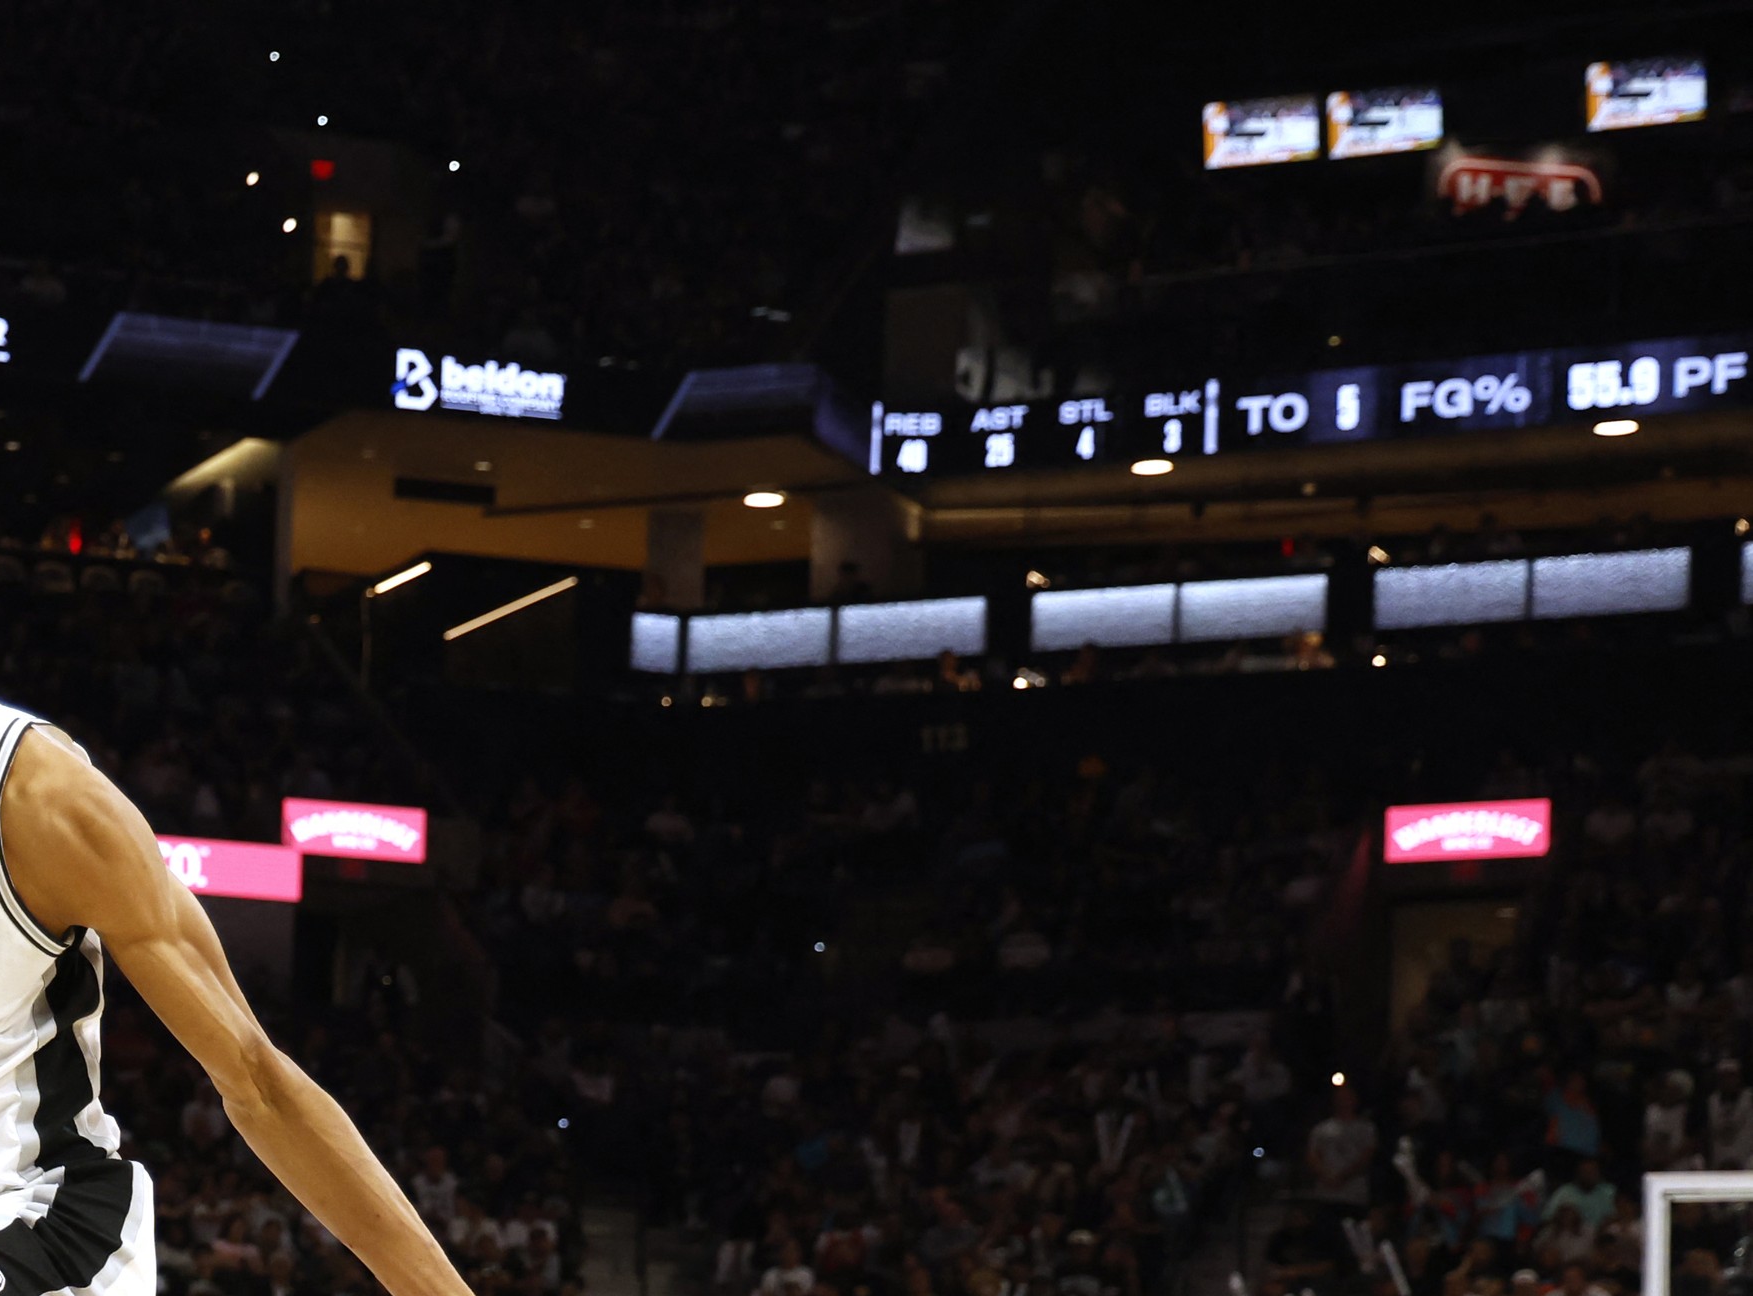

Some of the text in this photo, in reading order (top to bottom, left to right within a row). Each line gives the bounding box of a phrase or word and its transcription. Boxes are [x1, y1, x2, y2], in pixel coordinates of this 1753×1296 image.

[883, 389, 1201, 436] REB AST STL BLK
[1237, 392, 1309, 436] TO
[1400, 373, 1532, 422] FG%
[1672, 351, 1749, 399] PF
